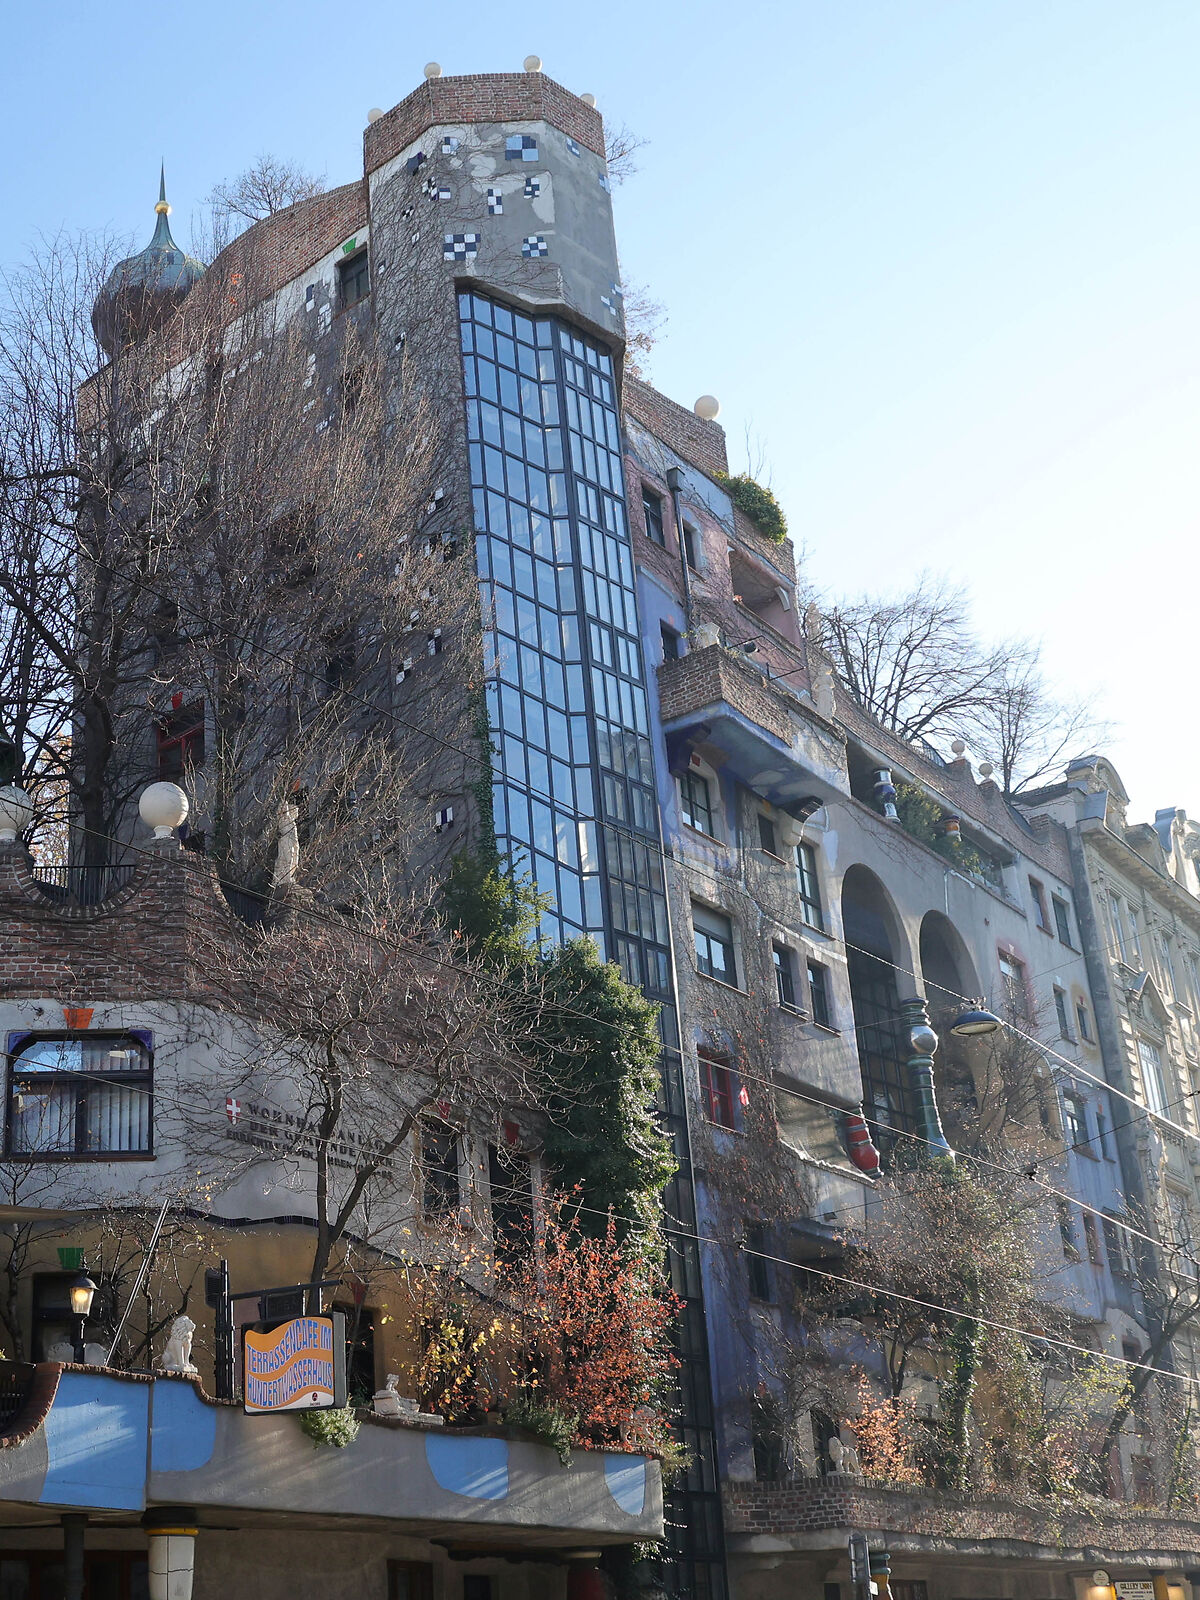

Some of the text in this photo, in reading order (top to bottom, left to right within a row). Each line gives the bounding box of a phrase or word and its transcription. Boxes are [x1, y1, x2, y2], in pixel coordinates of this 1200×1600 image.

[250, 1119, 279, 1137] DER
[247, 1319, 332, 1373] TERRASSENCAFE IM
[247, 1358, 333, 1407] HUNDERTWASSERHAUS
